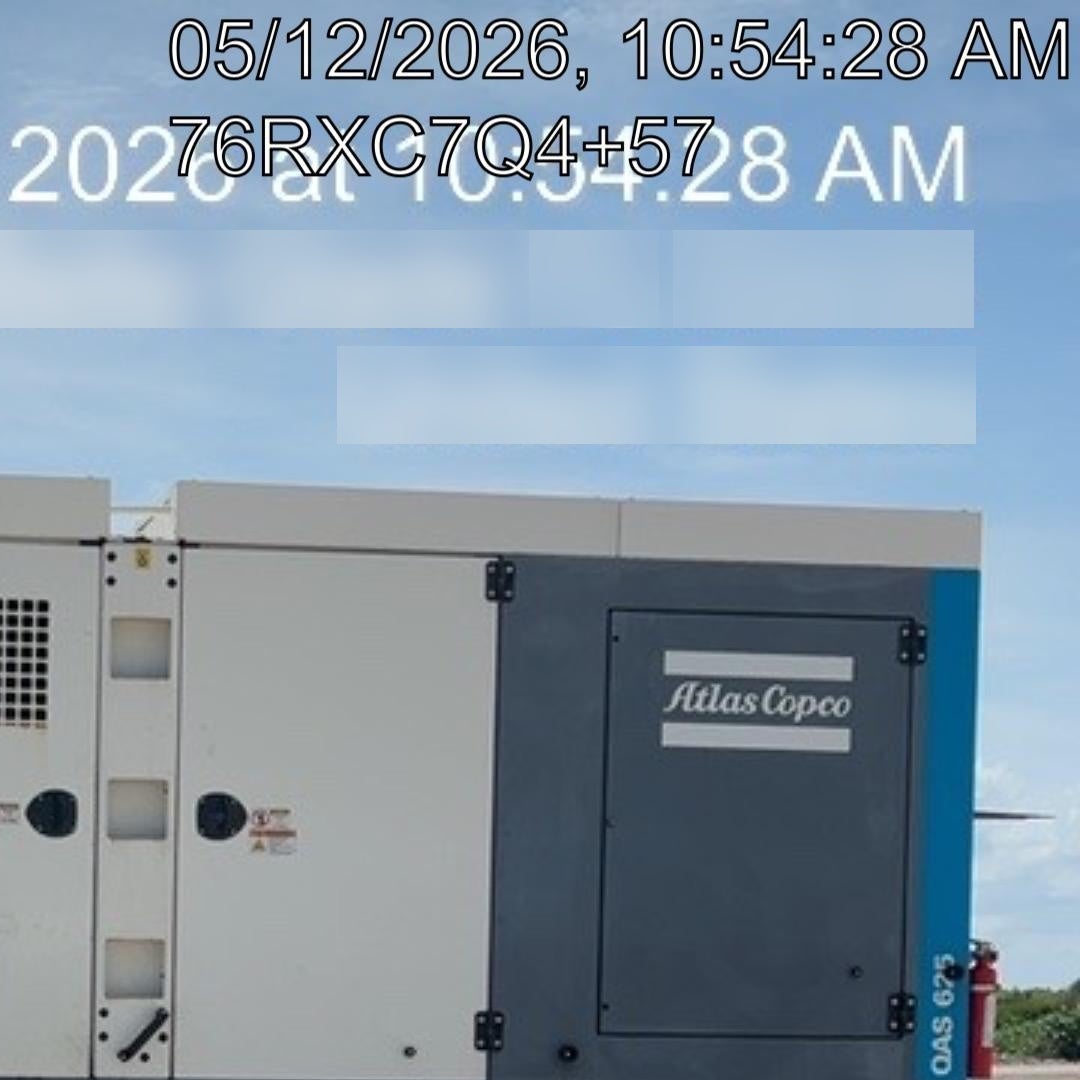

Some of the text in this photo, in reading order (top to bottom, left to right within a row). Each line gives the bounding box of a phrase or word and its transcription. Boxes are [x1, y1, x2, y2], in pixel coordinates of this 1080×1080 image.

[663, 681, 851, 723] Atlas Copco
[930, 1016, 954, 1076] QAS
